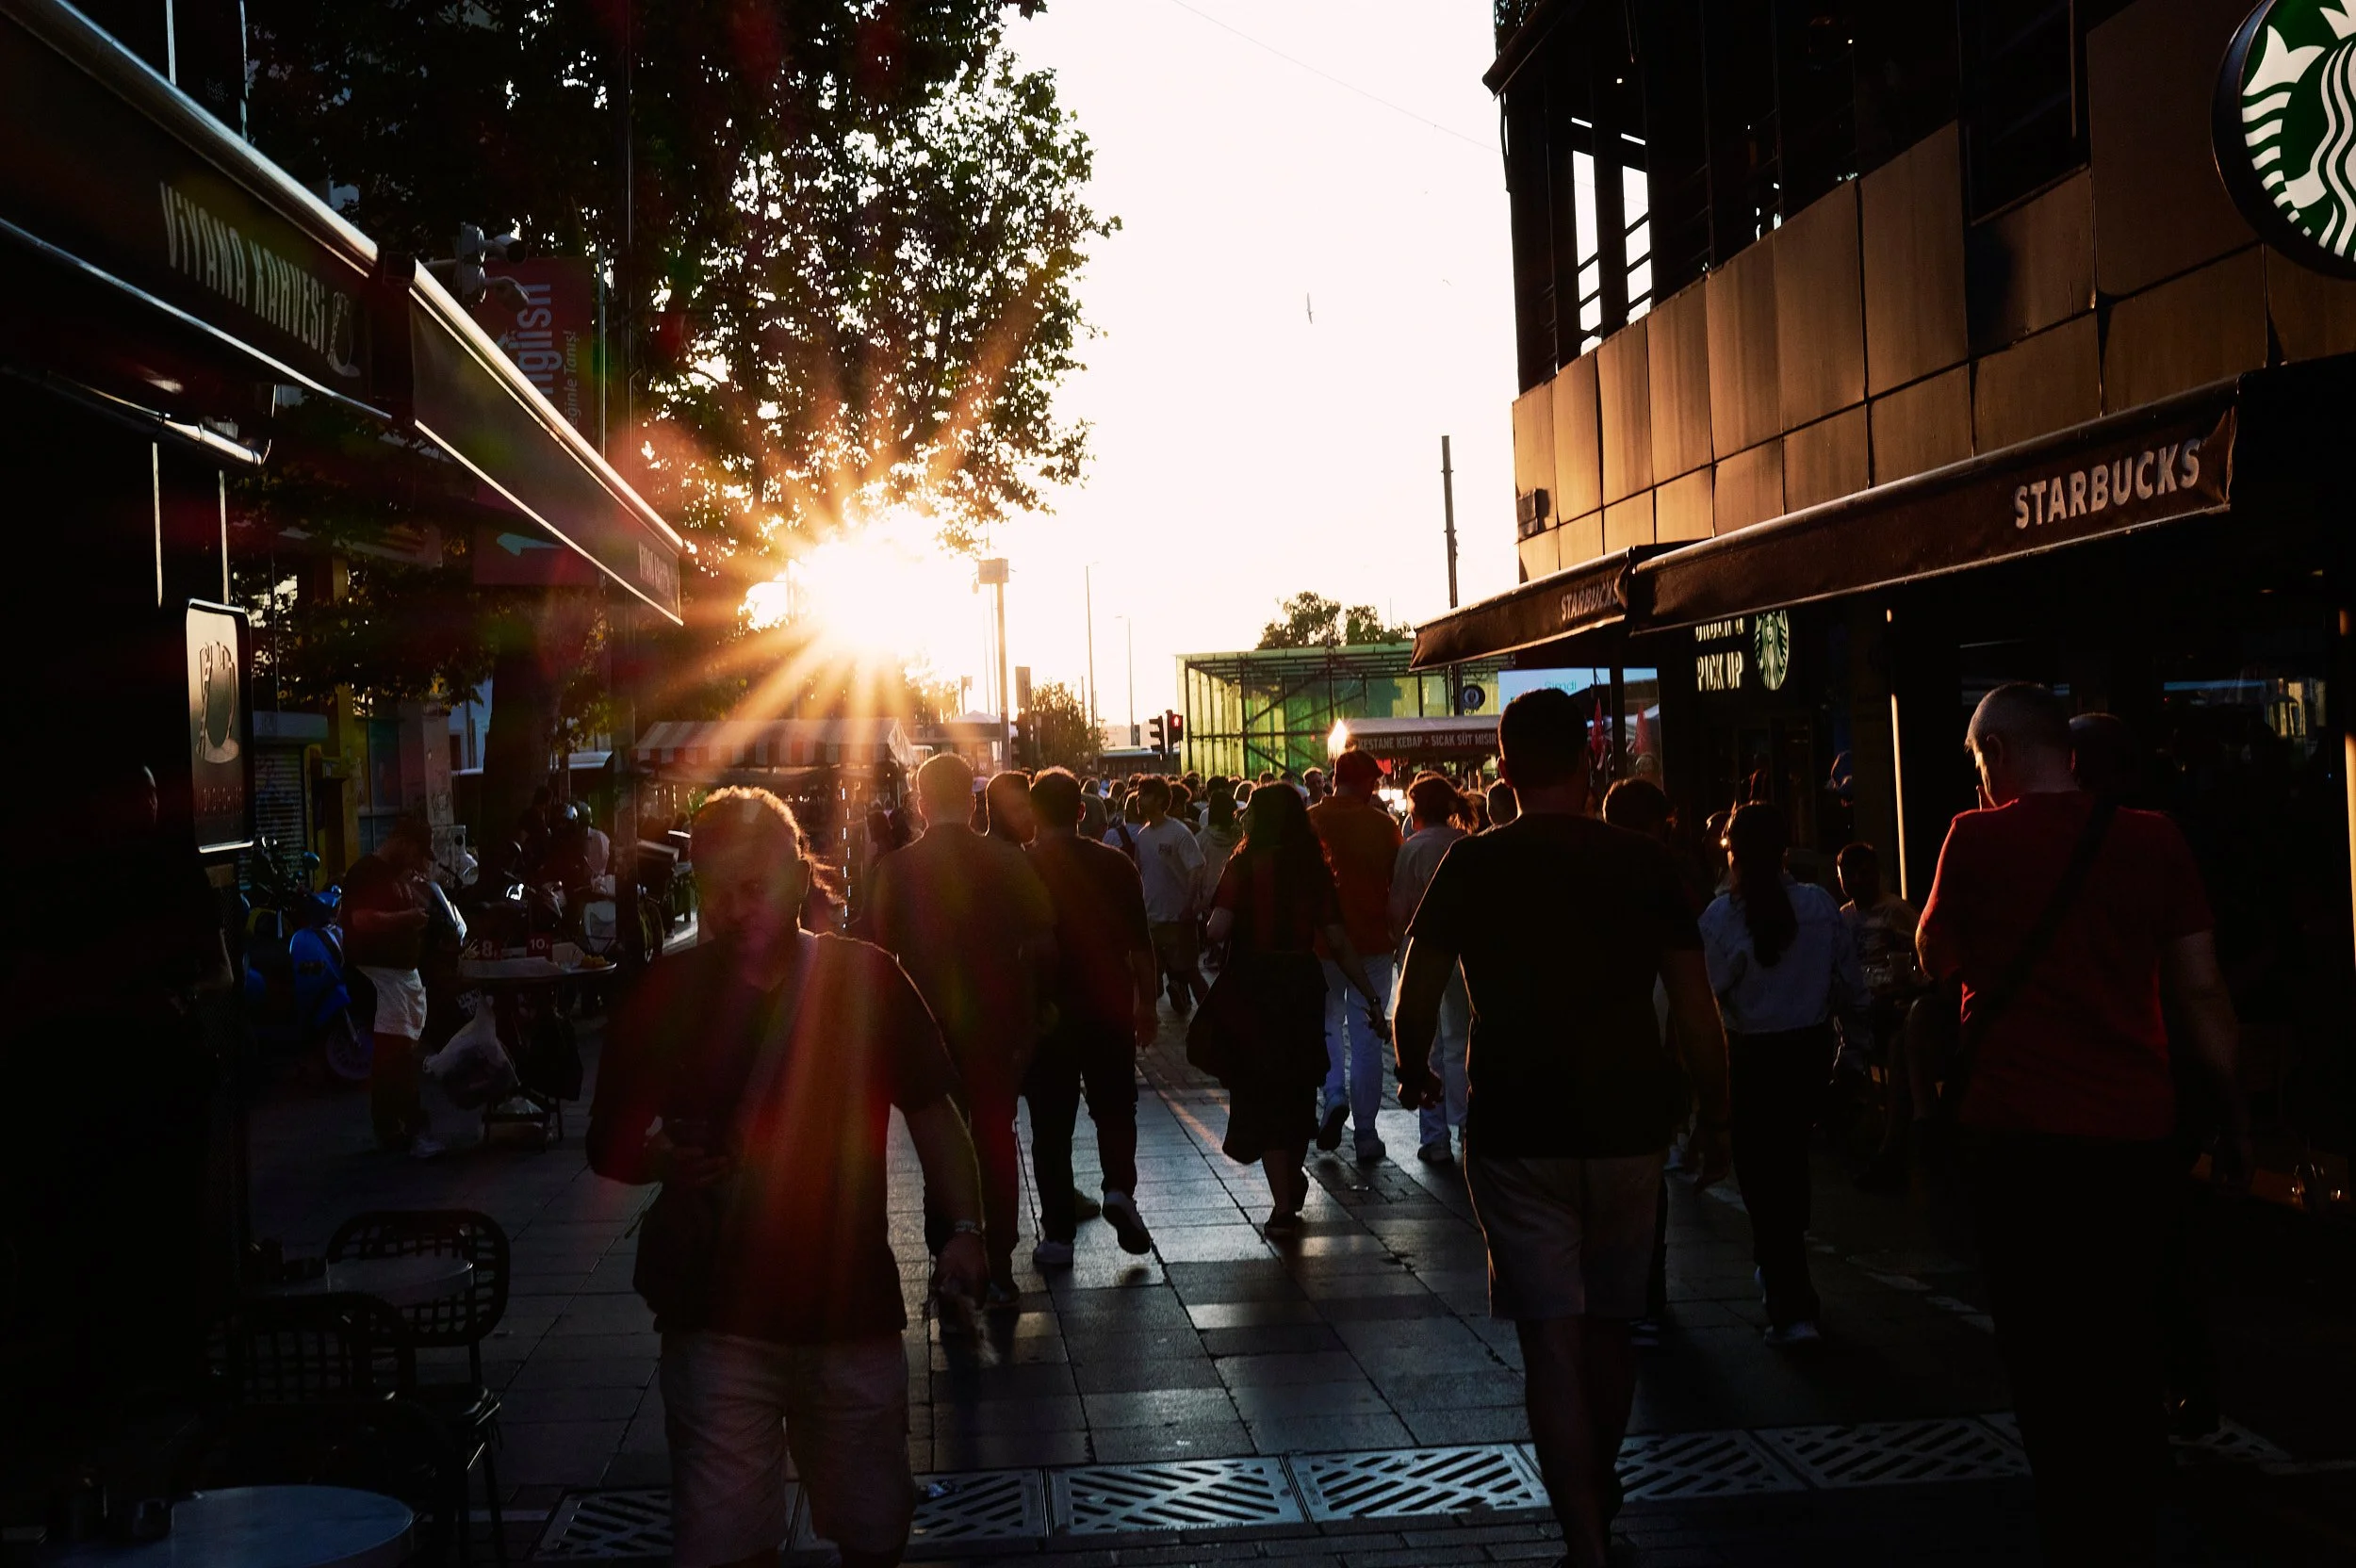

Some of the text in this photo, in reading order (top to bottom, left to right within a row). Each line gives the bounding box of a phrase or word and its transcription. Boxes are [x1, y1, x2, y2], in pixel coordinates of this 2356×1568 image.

[507, 284, 563, 396] nglish
[563, 379, 581, 430] eğinle
[2013, 437, 2201, 531] STARBUCKS
[1696, 649, 1744, 693] PICK UP
[1357, 737, 1394, 750] KESTANE
[1397, 735, 1423, 748] KEBAP
[1457, 732, 1474, 746] SÜT
